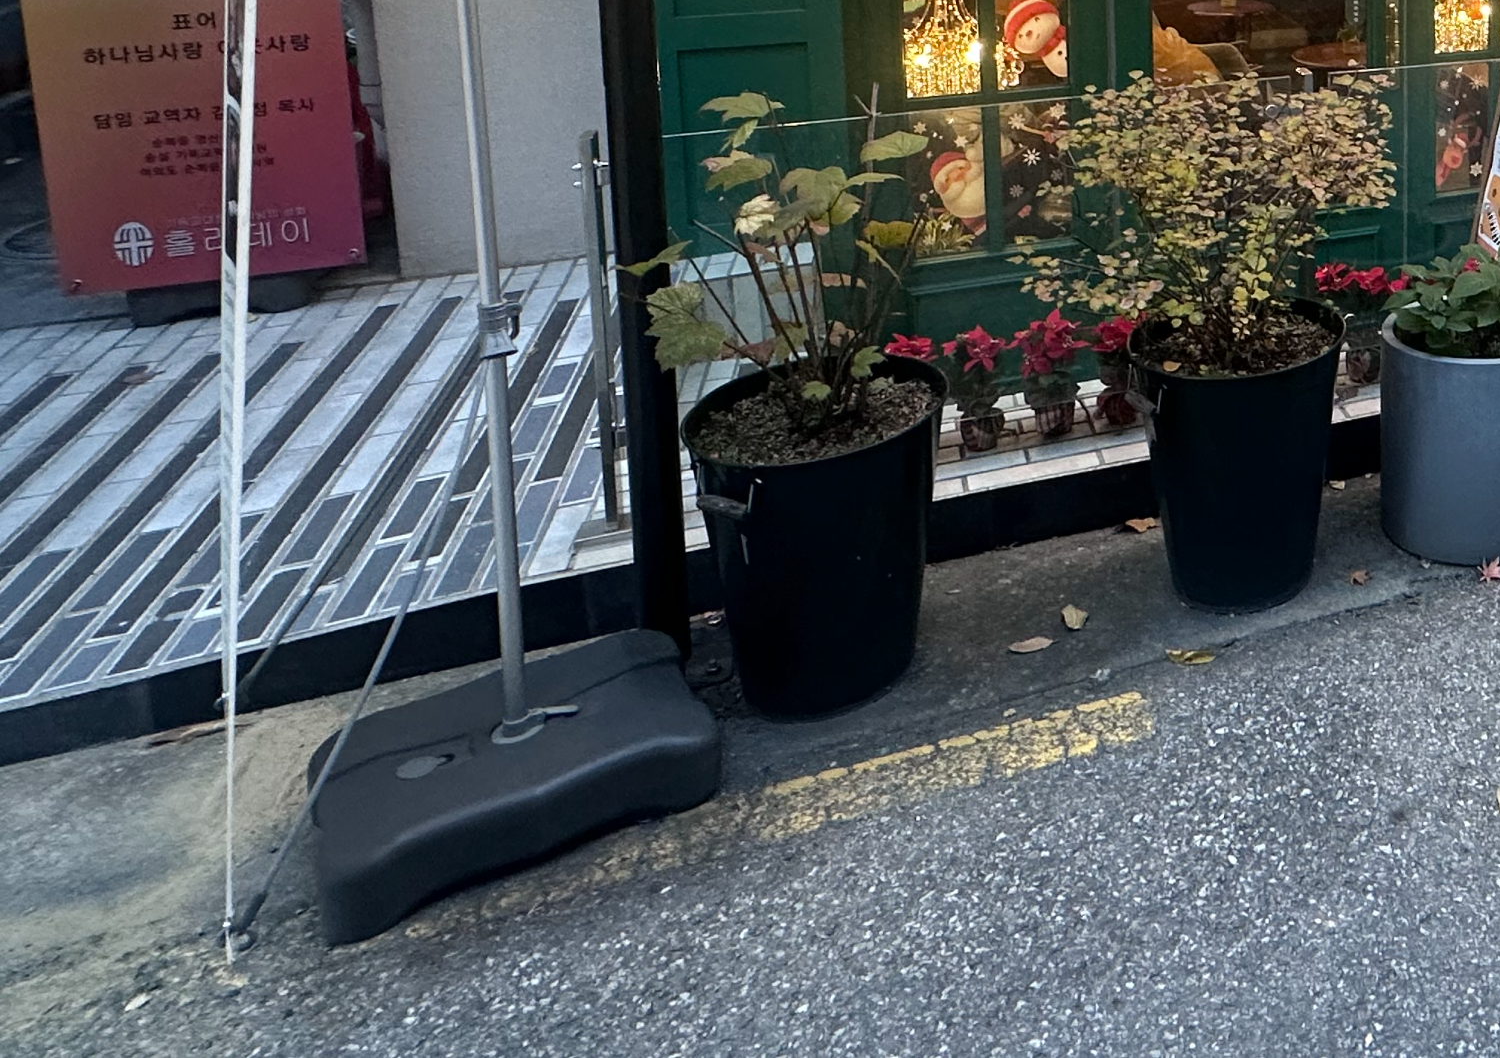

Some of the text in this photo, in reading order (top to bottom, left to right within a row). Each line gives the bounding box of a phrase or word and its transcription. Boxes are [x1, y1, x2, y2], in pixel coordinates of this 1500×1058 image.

[171, 11, 217, 31] 표어
[83, 42, 204, 66] 하나님사랑
[93, 111, 133, 130] 담임
[143, 106, 202, 125] 교역자
[278, 98, 315, 113] 목사
